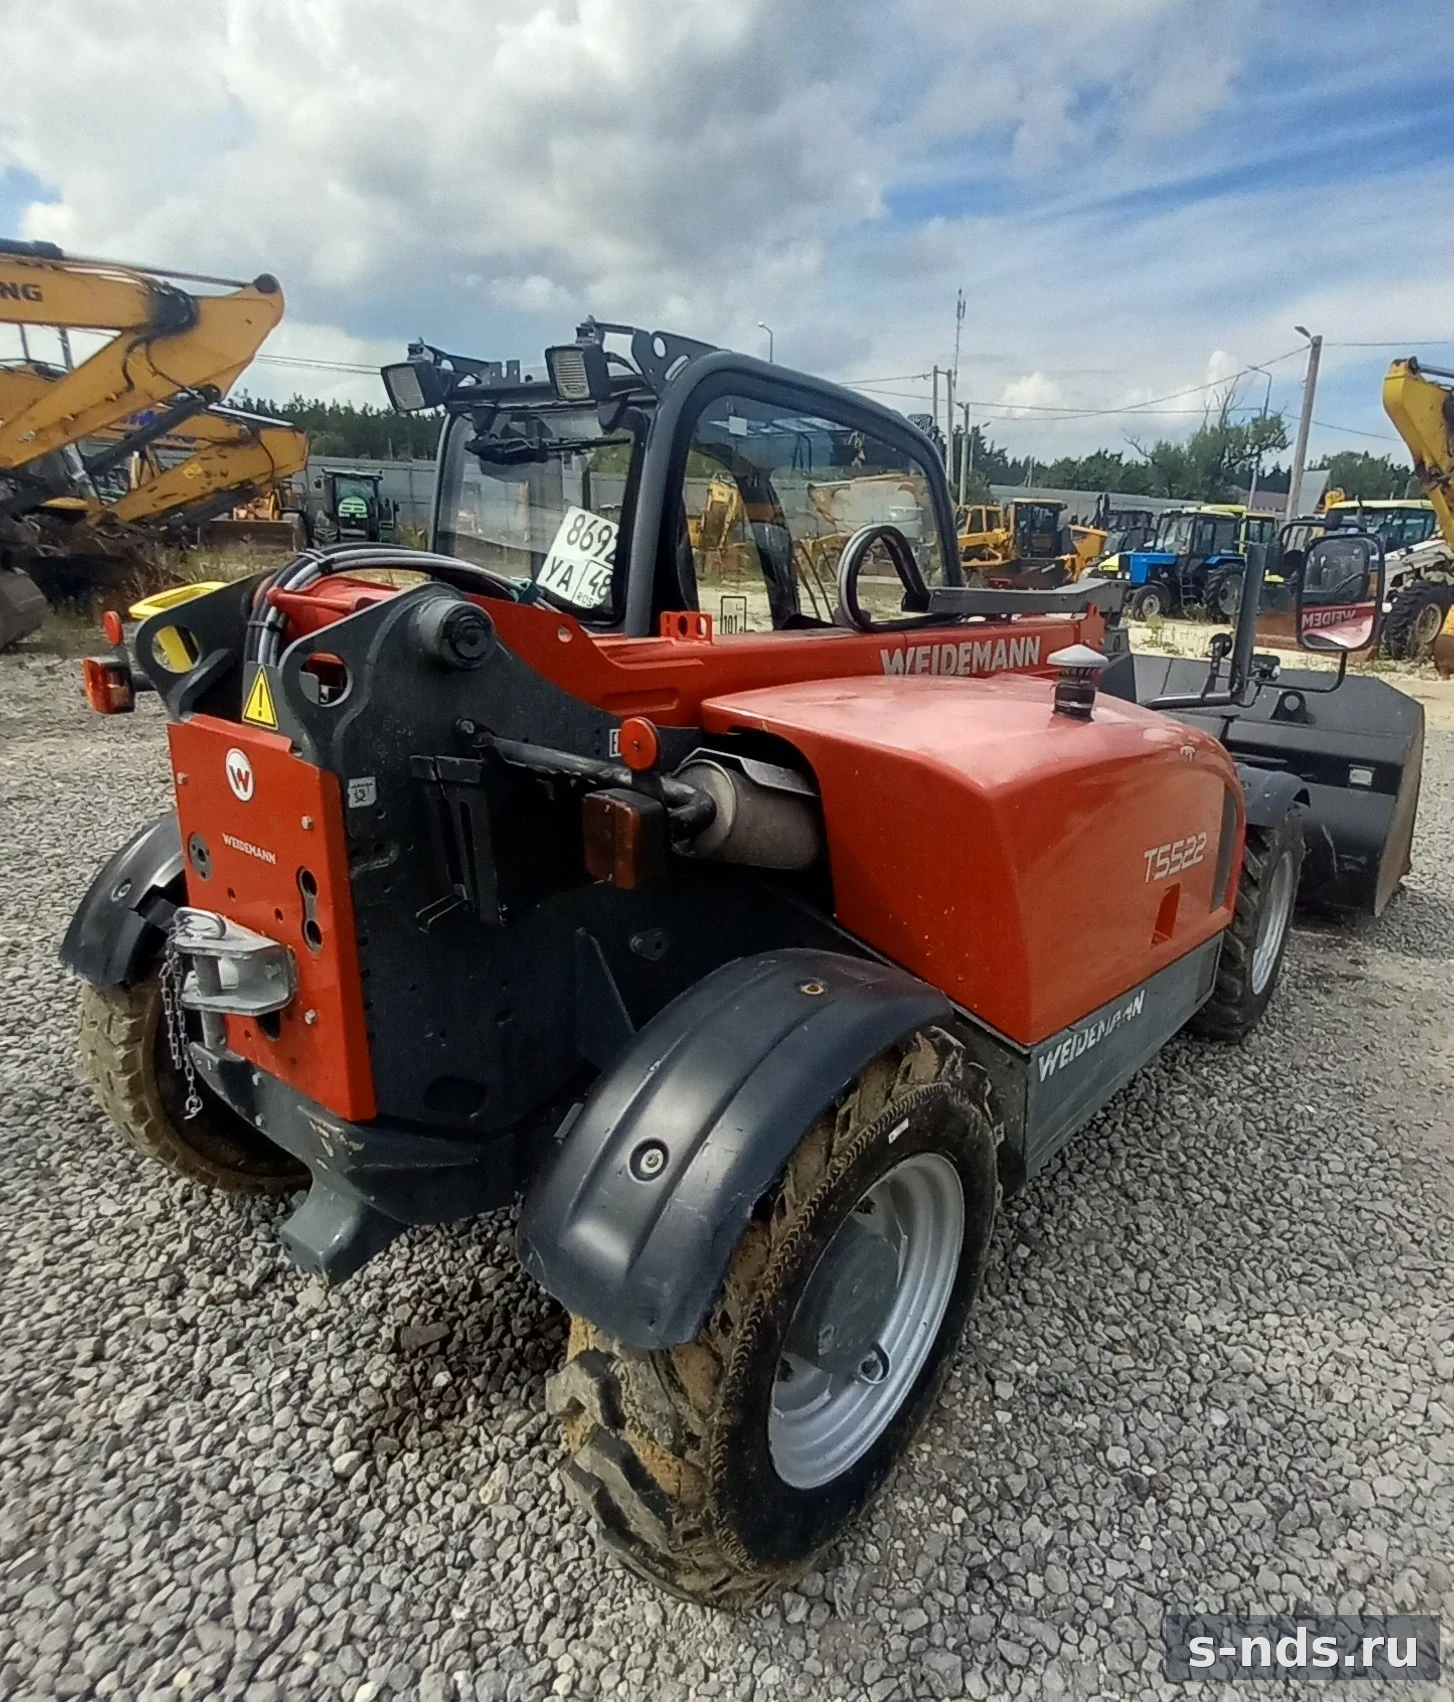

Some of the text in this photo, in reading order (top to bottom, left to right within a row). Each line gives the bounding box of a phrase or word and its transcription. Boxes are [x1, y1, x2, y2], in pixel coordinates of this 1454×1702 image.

[880, 635, 1041, 676] WEIDEMANN
[222, 832, 277, 865] WEIDEMANN
[1144, 831, 1207, 883] T5522
